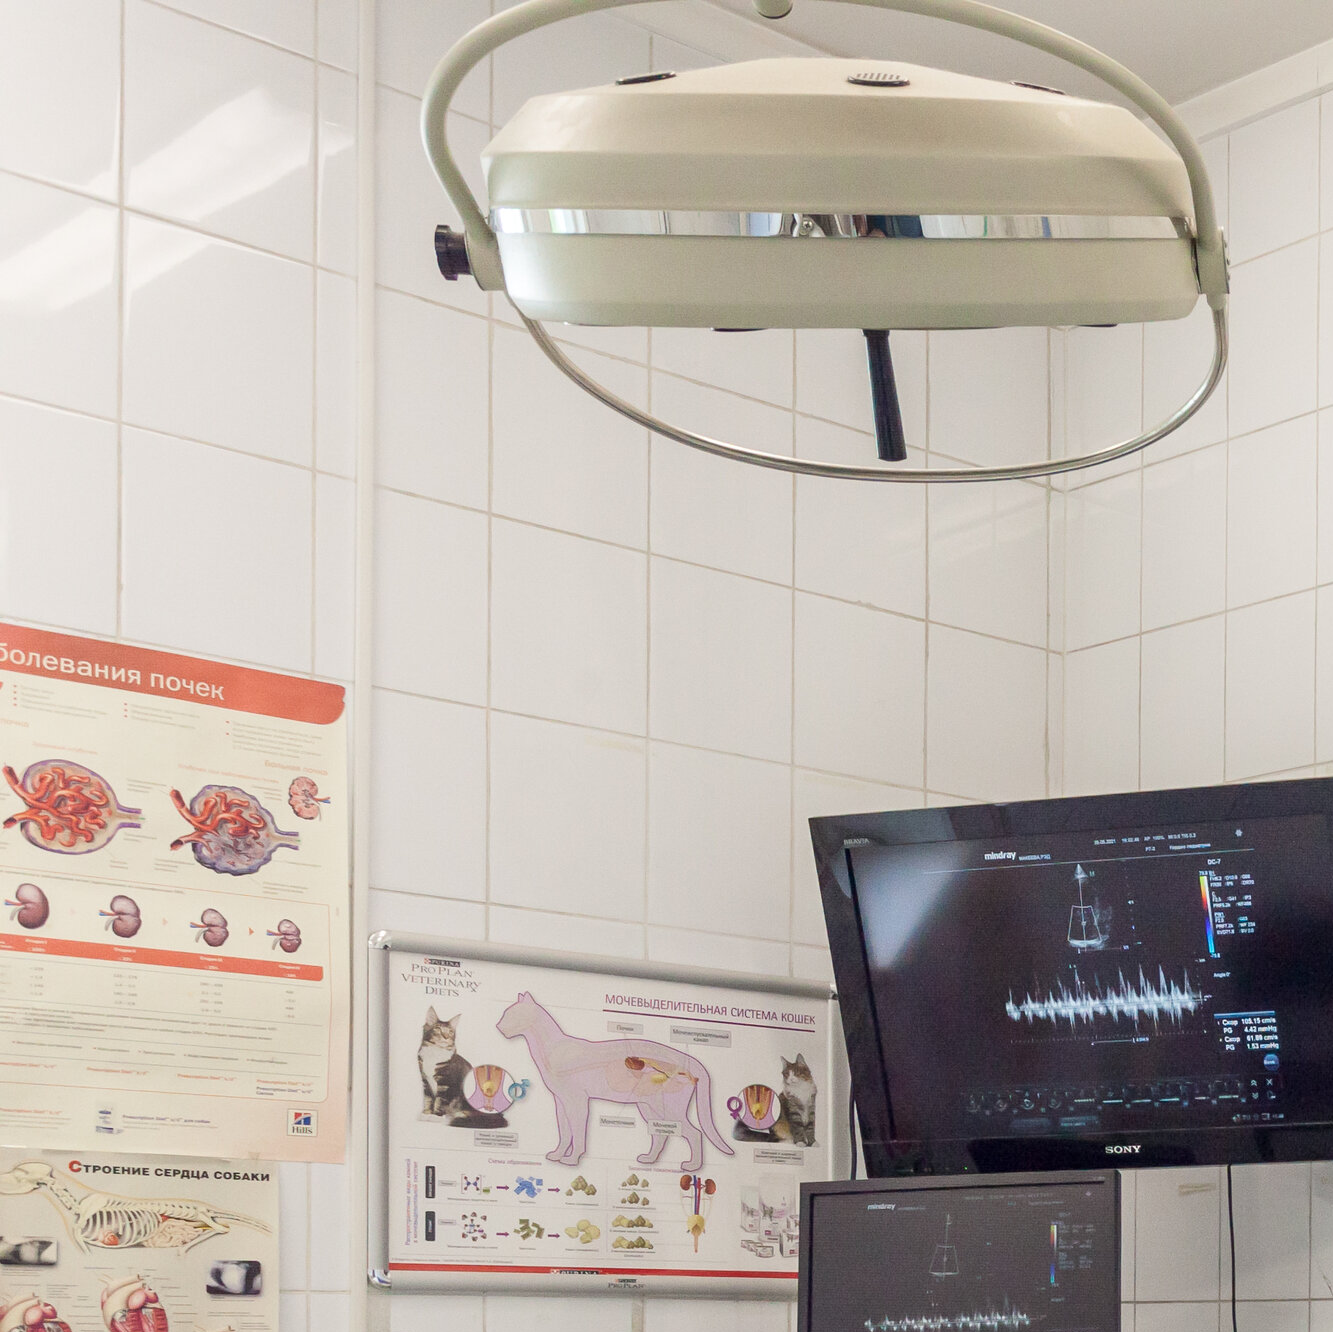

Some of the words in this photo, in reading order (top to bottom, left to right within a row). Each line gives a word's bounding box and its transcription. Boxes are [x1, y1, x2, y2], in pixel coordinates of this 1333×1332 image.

[150, 673, 223, 700] почек
[984, 850, 1016, 861] mindray
[412, 964, 436, 974] PRO
[438, 967, 472, 977] PLAN
[401, 974, 480, 992] VETERINARY
[425, 986, 459, 996] DIETS
[605, 994, 726, 1015] МОЧЕВЫДЕЛИТЕЛЬНАЯ
[730, 1007, 778, 1020] СИСТЕМА
[781, 1012, 815, 1024] КОШЕК
[1105, 1145, 1141, 1154] SONY
[68, 1160, 149, 1176] СТРОЕНИЕ
[154, 1167, 209, 1179] СЕРДЦА
[213, 1170, 269, 1181] СОБАКИ
